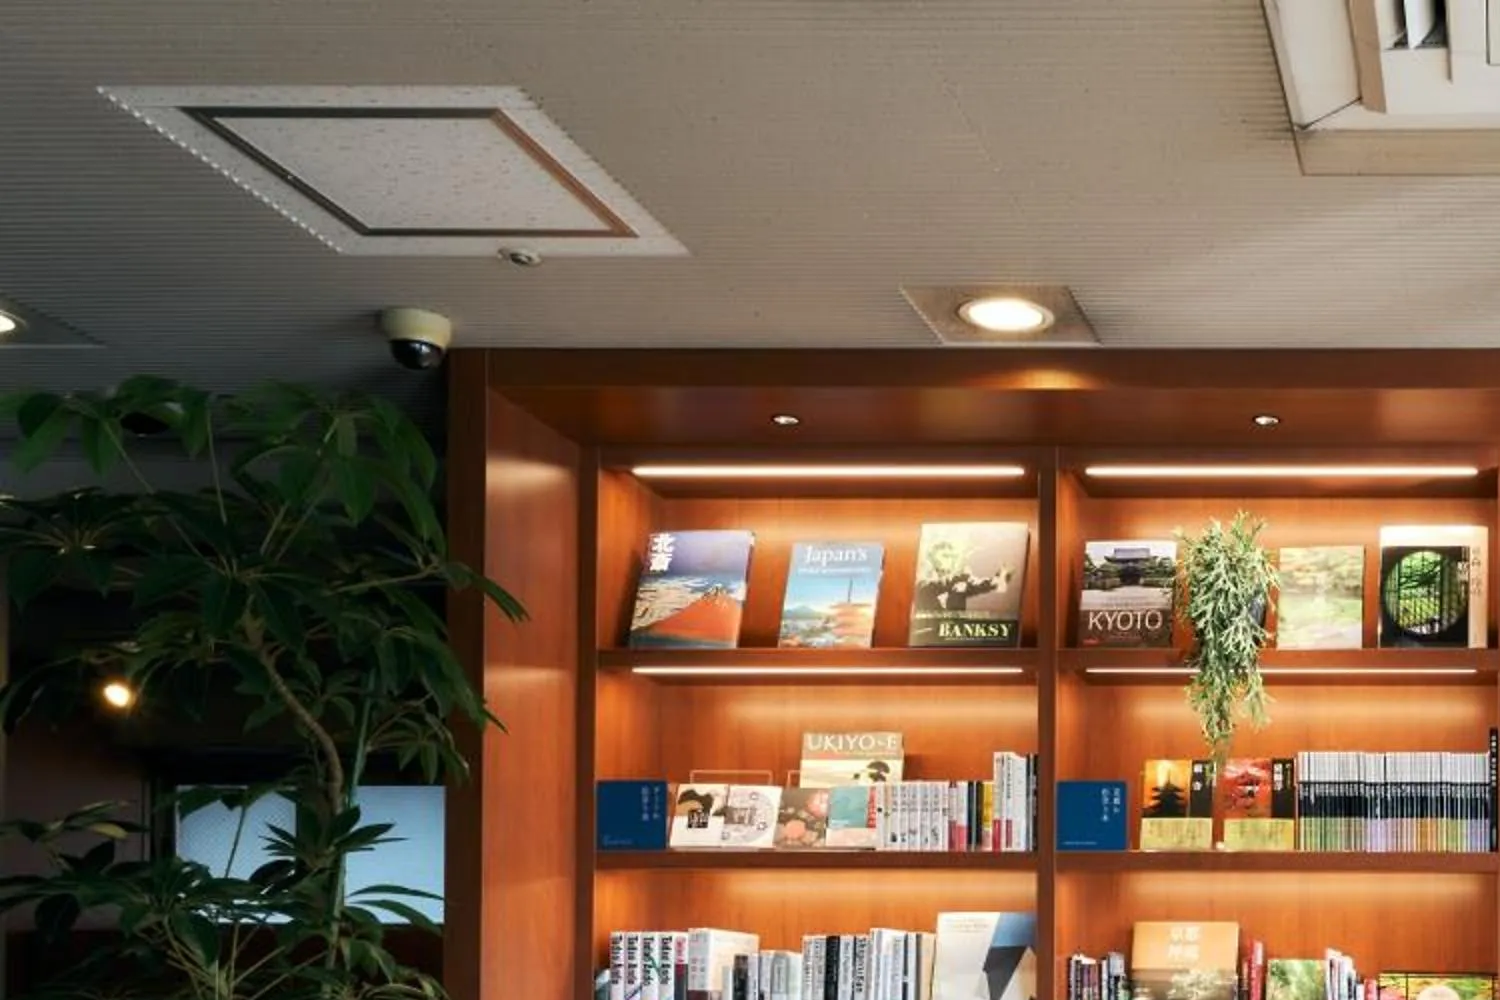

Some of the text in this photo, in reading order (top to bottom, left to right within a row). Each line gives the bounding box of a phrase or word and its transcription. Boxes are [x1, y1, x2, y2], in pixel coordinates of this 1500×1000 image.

[805, 545, 868, 567] Japan's
[938, 622, 1011, 638] BANKSY
[1088, 610, 1164, 631] KYOTO
